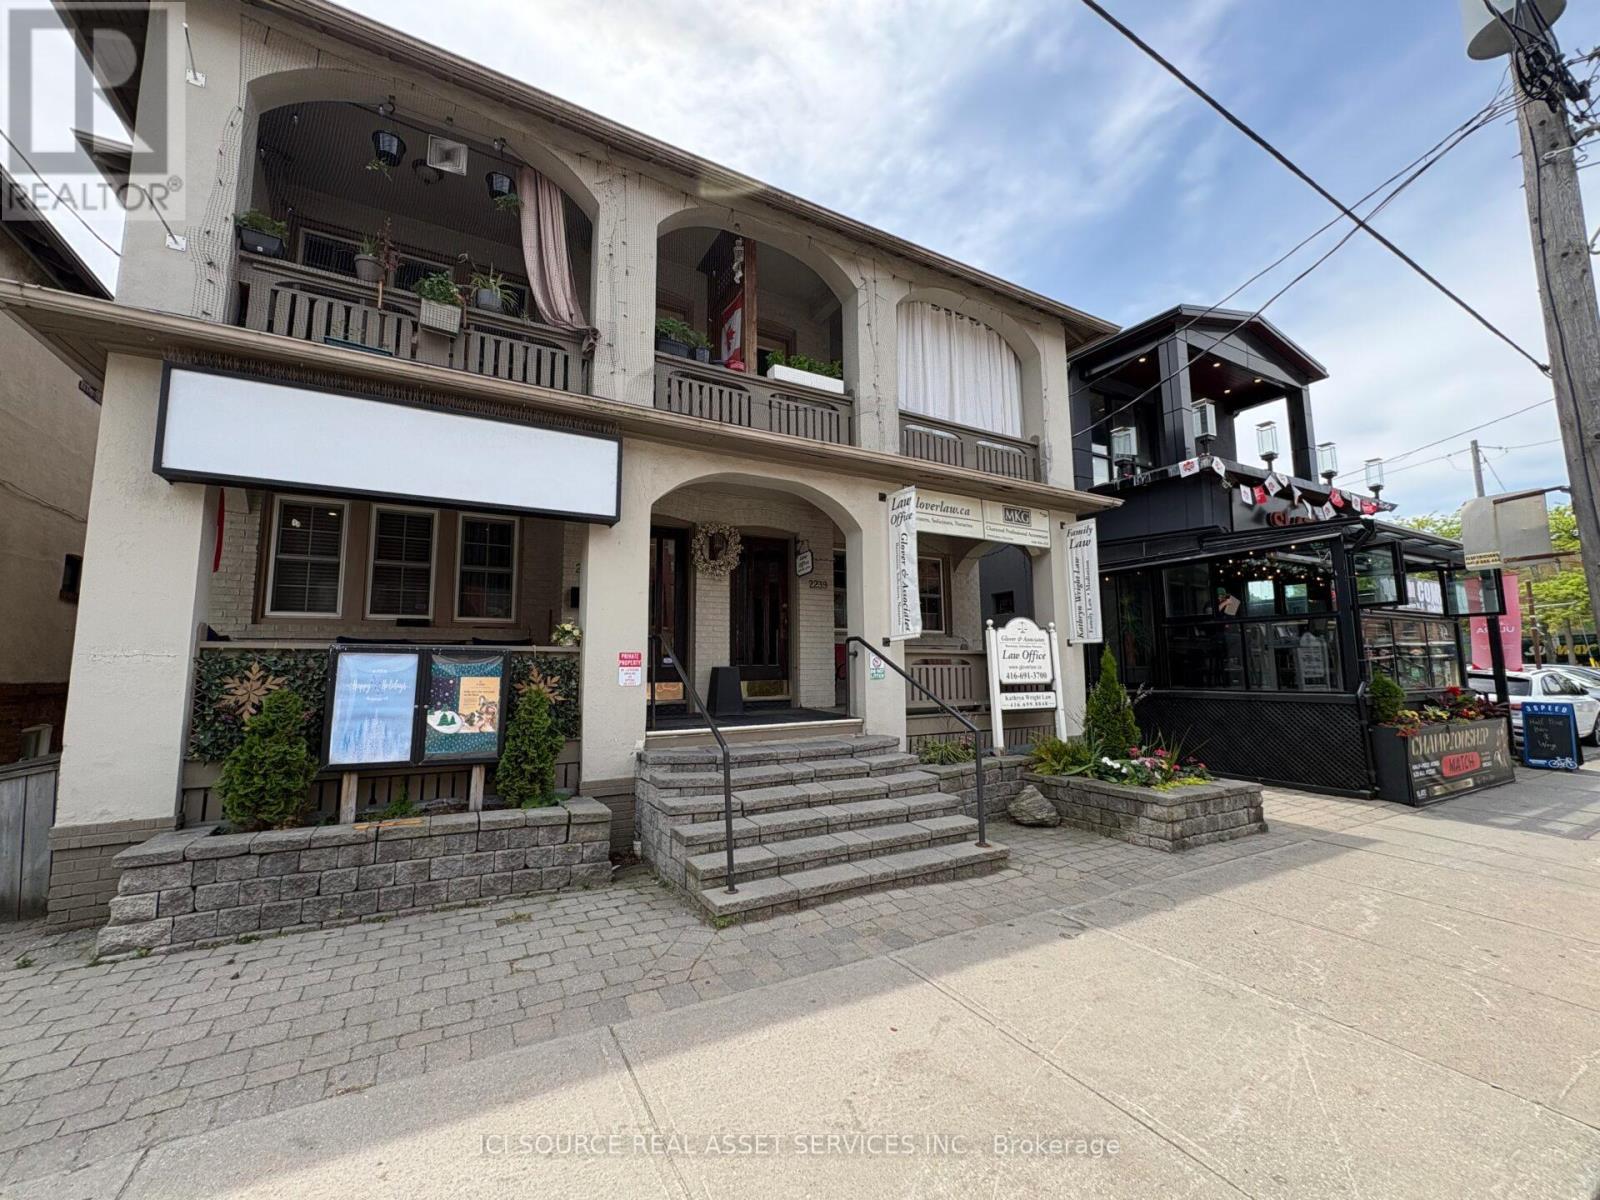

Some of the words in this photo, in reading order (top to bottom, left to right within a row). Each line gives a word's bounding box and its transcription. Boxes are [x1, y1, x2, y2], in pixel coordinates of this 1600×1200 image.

[892, 496, 912, 511] Law
[915, 497, 970, 516] loverlaw.ca
[890, 510, 913, 527] Office
[1003, 507, 1030, 523] MKG
[1067, 525, 1093, 538] Family
[1069, 538, 1091, 550] Law
[902, 569, 909, 579] &
[1074, 574, 1083, 602] Wright
[902, 581, 911, 631] Associates
[1076, 605, 1085, 638] Kathryn
[1002, 650, 1020, 660] Law
[1022, 650, 1046, 663] Office
[1006, 671, 1048, 680] 416-691-3700
[1411, 727, 1489, 756] CHAMPIONSHIP
[1449, 754, 1475, 771] MATCH
